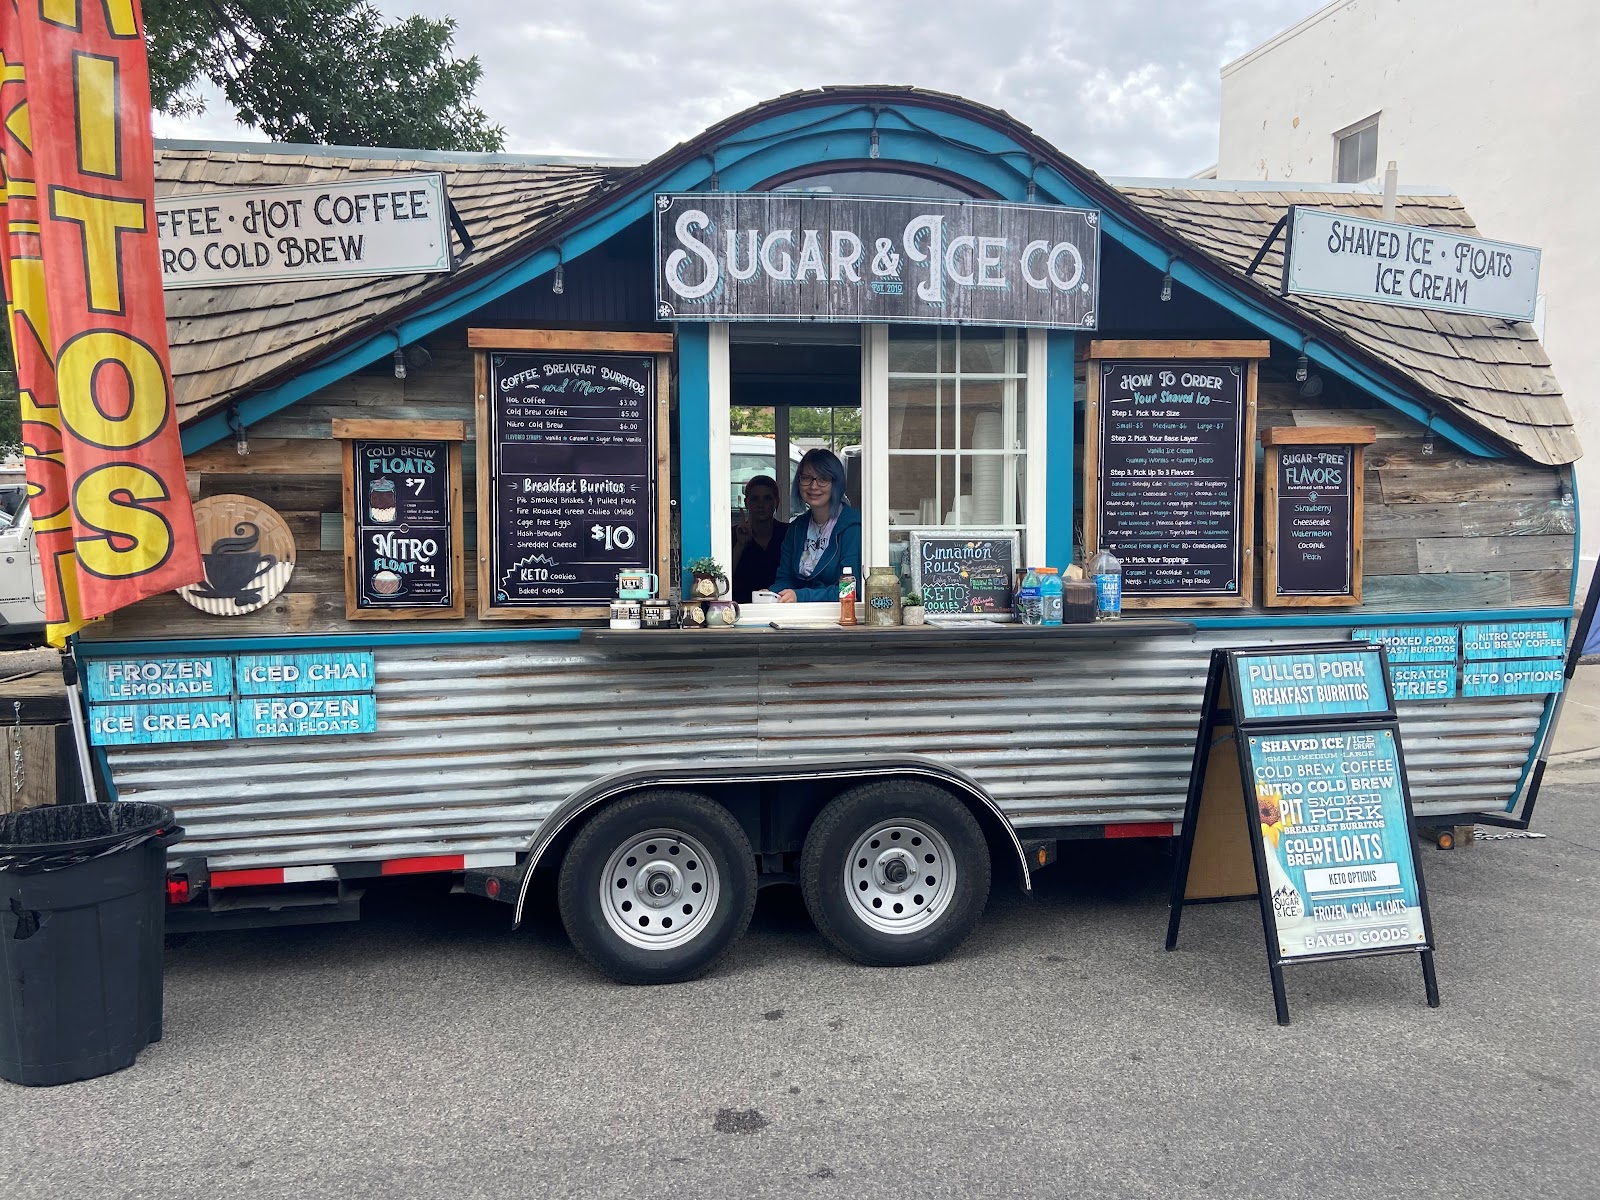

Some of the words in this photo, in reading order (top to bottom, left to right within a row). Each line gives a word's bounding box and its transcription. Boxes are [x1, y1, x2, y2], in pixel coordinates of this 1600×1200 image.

[242, 199, 302, 239] HOT
[313, 189, 429, 226] COFFEE
[204, 242, 271, 271] COLD
[277, 234, 364, 268] BREW
[664, 209, 863, 300] SUGAR
[871, 237, 900, 277] &
[903, 214, 1007, 302] ICE
[1020, 239, 1091, 293] CO.
[1327, 220, 1400, 260] SHAVED
[1405, 231, 1434, 266] ICE
[1454, 242, 1513, 280] FLOATS
[38, 0, 174, 581] ITOS
[886, 284, 903, 293] 2019
[1375, 262, 1405, 296] ICE
[1409, 268, 1469, 305] CREAM
[542, 378, 570, 394] and
[569, 378, 607, 396] More
[543, 363, 597, 377] BREAKFAST
[601, 366, 646, 396] BURRITOS
[1120, 373, 1154, 391] HOW
[1181, 372, 1223, 390] ORDER
[506, 396, 520, 404] Hot
[522, 396, 546, 405] Coffee
[619, 399, 638, 407] $3.00
[1133, 391, 1157, 405] Your
[1160, 391, 1194, 404] Shaved
[1196, 392, 1211, 406] Ice
[506, 408, 522, 416] Cold
[525, 408, 542, 416] Brew
[544, 408, 568, 417] Coffee
[621, 410, 640, 418] $5.00
[1111, 410, 1127, 418] Step
[506, 420, 525, 428] Nitro
[528, 421, 544, 429] Cold
[546, 421, 564, 429] Brew
[619, 423, 638, 431] $6.00
[1111, 435, 1127, 443] Step
[1180, 435, 1199, 443] Layer
[366, 446, 396, 458] COLD
[401, 445, 436, 459] BREW
[1282, 453, 1345, 466] SUGAR-FREE
[369, 458, 436, 475] FLOATS
[1285, 465, 1343, 485] FLAVORS
[405, 477, 426, 496] $7
[523, 477, 577, 494] Breakfast
[580, 479, 626, 494] Burritos
[517, 496, 528, 504] Pit
[530, 496, 558, 505] Smoked
[597, 497, 618, 505] Pulled
[532, 508, 561, 516] Roasted
[614, 508, 634, 516] (Mild)
[1294, 504, 1332, 515] Strawberry
[516, 519, 534, 528] Cage
[554, 519, 572, 528] Eggs
[1292, 518, 1331, 526] Cheesecake
[591, 524, 636, 551] $10
[1290, 530, 1332, 538] Watermelon
[372, 531, 439, 563] NITRO
[516, 541, 549, 549] Shredded
[923, 541, 992, 561] Cinnamon
[1302, 552, 1322, 561] Peach
[374, 558, 417, 574] FLOAT
[419, 565, 436, 578] $4
[520, 568, 549, 581] KETO
[923, 560, 961, 575] ROLLS
[622, 579, 640, 587] YETI
[518, 587, 539, 595] Baked
[542, 587, 565, 595] Goods
[923, 586, 965, 601] KETO
[924, 601, 960, 610] COOKIES
[1426, 635, 1456, 645] PORK
[1478, 633, 1508, 641] NITRO
[1511, 631, 1549, 640] COFFEE
[1410, 645, 1456, 654] BURRITOS
[1465, 641, 1491, 650] COLD
[1495, 640, 1523, 649] BREW
[1526, 638, 1563, 648] COFFEE
[108, 661, 213, 682] FROZEN
[244, 665, 300, 683] ICED
[308, 663, 367, 681] CHAI
[1249, 663, 1315, 682] PULLED
[1319, 660, 1366, 679] PORK
[1396, 669, 1449, 680] SCRATCH
[1463, 673, 1499, 686] KETO
[1503, 670, 1563, 684] OPTIONS
[109, 681, 213, 697] LEMONADE
[1252, 685, 1315, 706] BREAKFAST
[1317, 683, 1370, 703] BURRITOS
[255, 700, 359, 720] FROZEN
[95, 717, 134, 734] ICE
[143, 712, 231, 731] CREAM
[256, 722, 294, 734] CHAI
[300, 720, 360, 732] FLOATS
[1261, 738, 1320, 753] SHAVED
[1321, 737, 1345, 750] ICE
[1352, 735, 1375, 744] ICE
[1353, 742, 1376, 751] CREAM
[1267, 755, 1300, 763] SMALL
[1301, 752, 1338, 762] MEDIUM
[1342, 750, 1375, 759] LARGE
[1255, 765, 1293, 779] COLD
[1297, 763, 1335, 778] BREW
[1340, 759, 1394, 774] COFFEE
[1259, 782, 1303, 797] NITRO
[1307, 779, 1347, 794] COLD
[1351, 776, 1394, 791] BREW
[1279, 799, 1304, 825] PIT
[1308, 793, 1382, 808] SMOKED
[1309, 805, 1384, 824] PORK
[1284, 823, 1338, 835] BREAKFAST
[1339, 820, 1385, 832] BURRITOS
[1285, 838, 1323, 854] COLD
[1323, 834, 1383, 864] FLOATS
[1287, 852, 1324, 867] BREW
[1328, 872, 1347, 886] KETO
[1347, 870, 1377, 884] OPTIONS
[1273, 896, 1300, 910] SUGAR
[1313, 903, 1349, 921] FROZEN
[1352, 902, 1373, 918] CHAI
[1375, 898, 1407, 915] FLOATS
[1282, 906, 1298, 917] ICE
[1305, 932, 1356, 949] BAKED
[1359, 927, 1410, 944] GOODS
